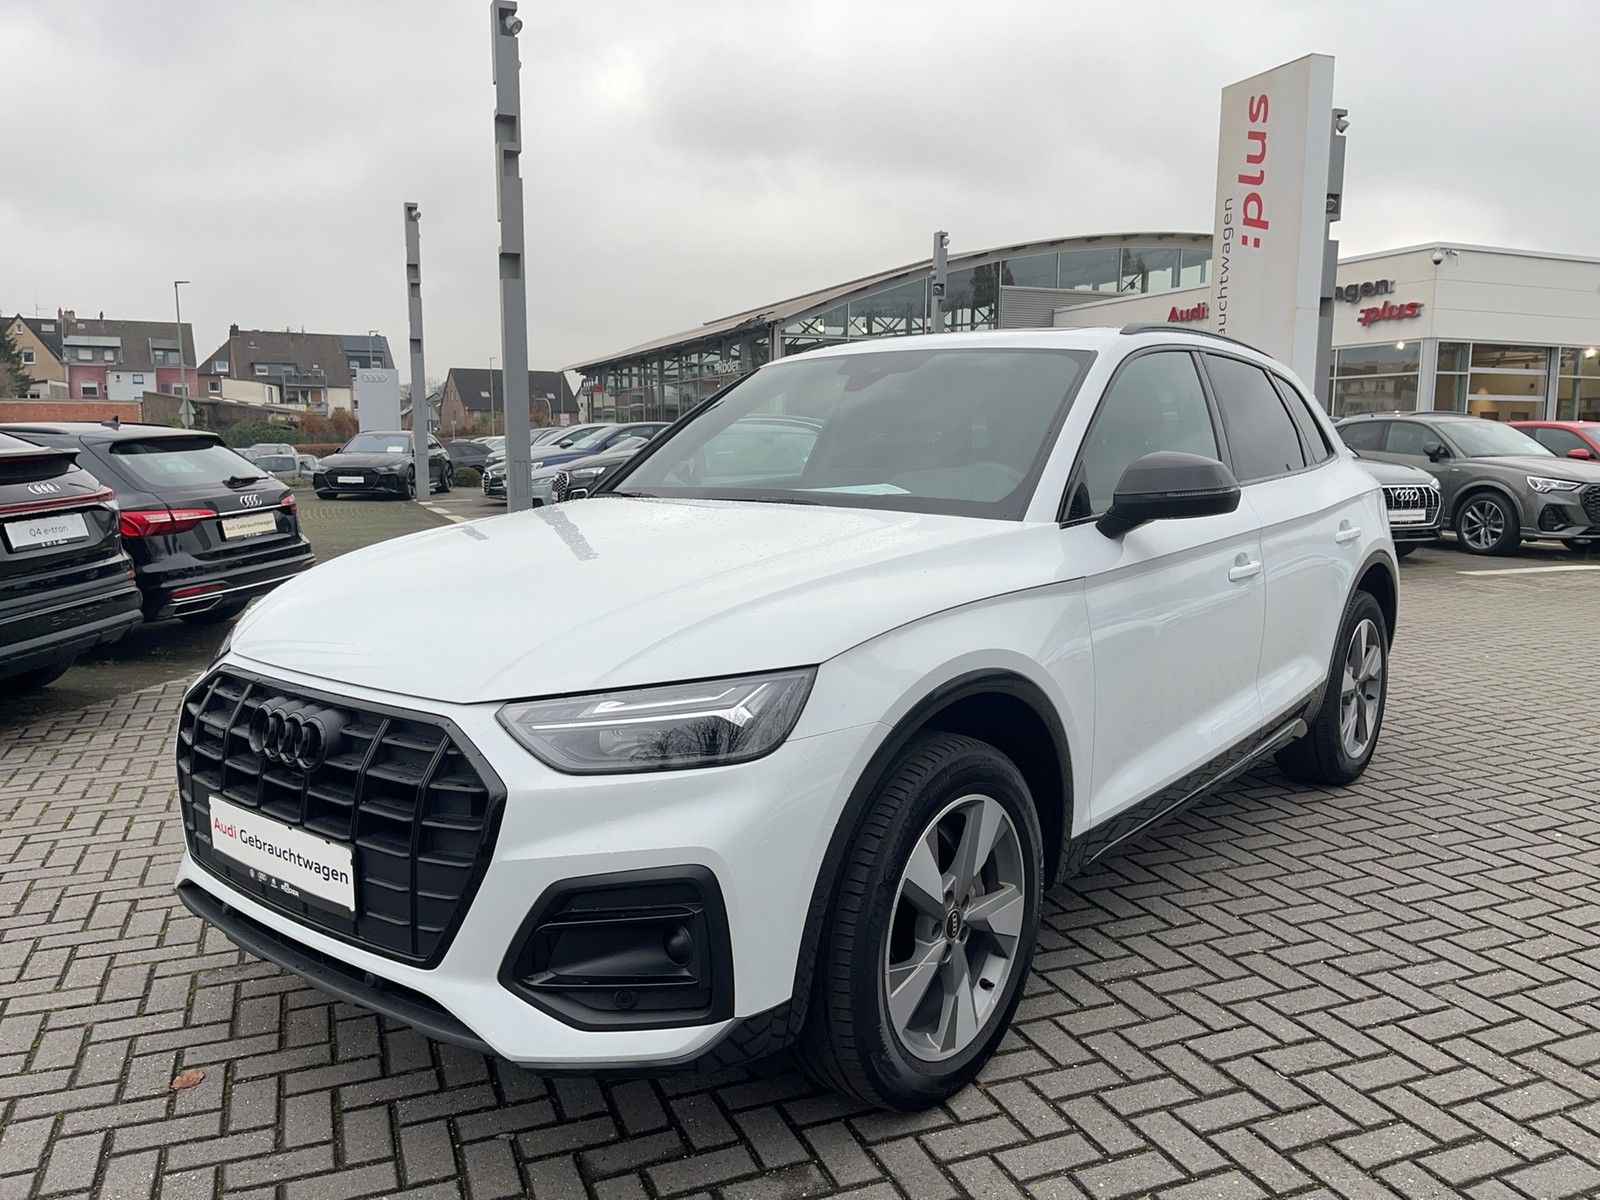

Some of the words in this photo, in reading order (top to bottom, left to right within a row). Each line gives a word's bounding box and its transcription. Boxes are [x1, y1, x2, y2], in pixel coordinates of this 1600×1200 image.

[1237, 94, 1269, 248] :plus
[1167, 302, 1208, 322] Audi
[29, 528, 42, 537] Q4
[43, 525, 69, 535] e-tron
[214, 817, 237, 840] Audi
[239, 829, 349, 885] Gebrauchtwagen
